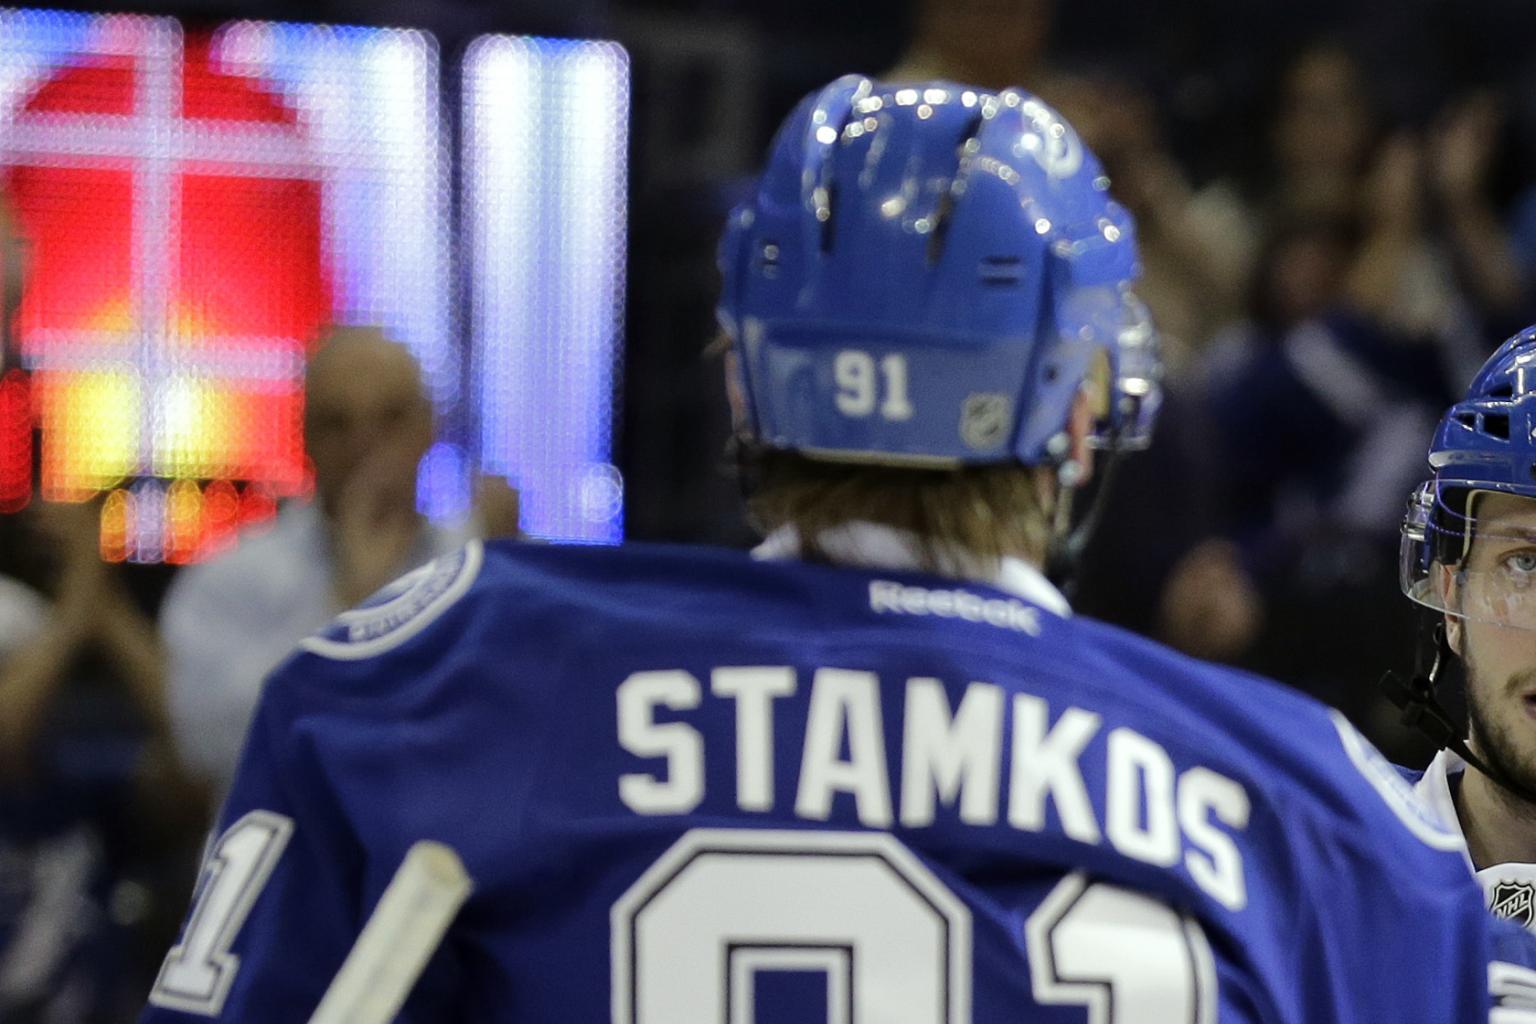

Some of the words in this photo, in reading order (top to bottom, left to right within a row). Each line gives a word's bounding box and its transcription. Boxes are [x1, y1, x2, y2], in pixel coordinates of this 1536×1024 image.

[834, 350, 914, 420] 91
[868, 579, 1041, 636] Reebok
[616, 666, 1252, 910] STAMKOS
[148, 809, 296, 1018] 1
